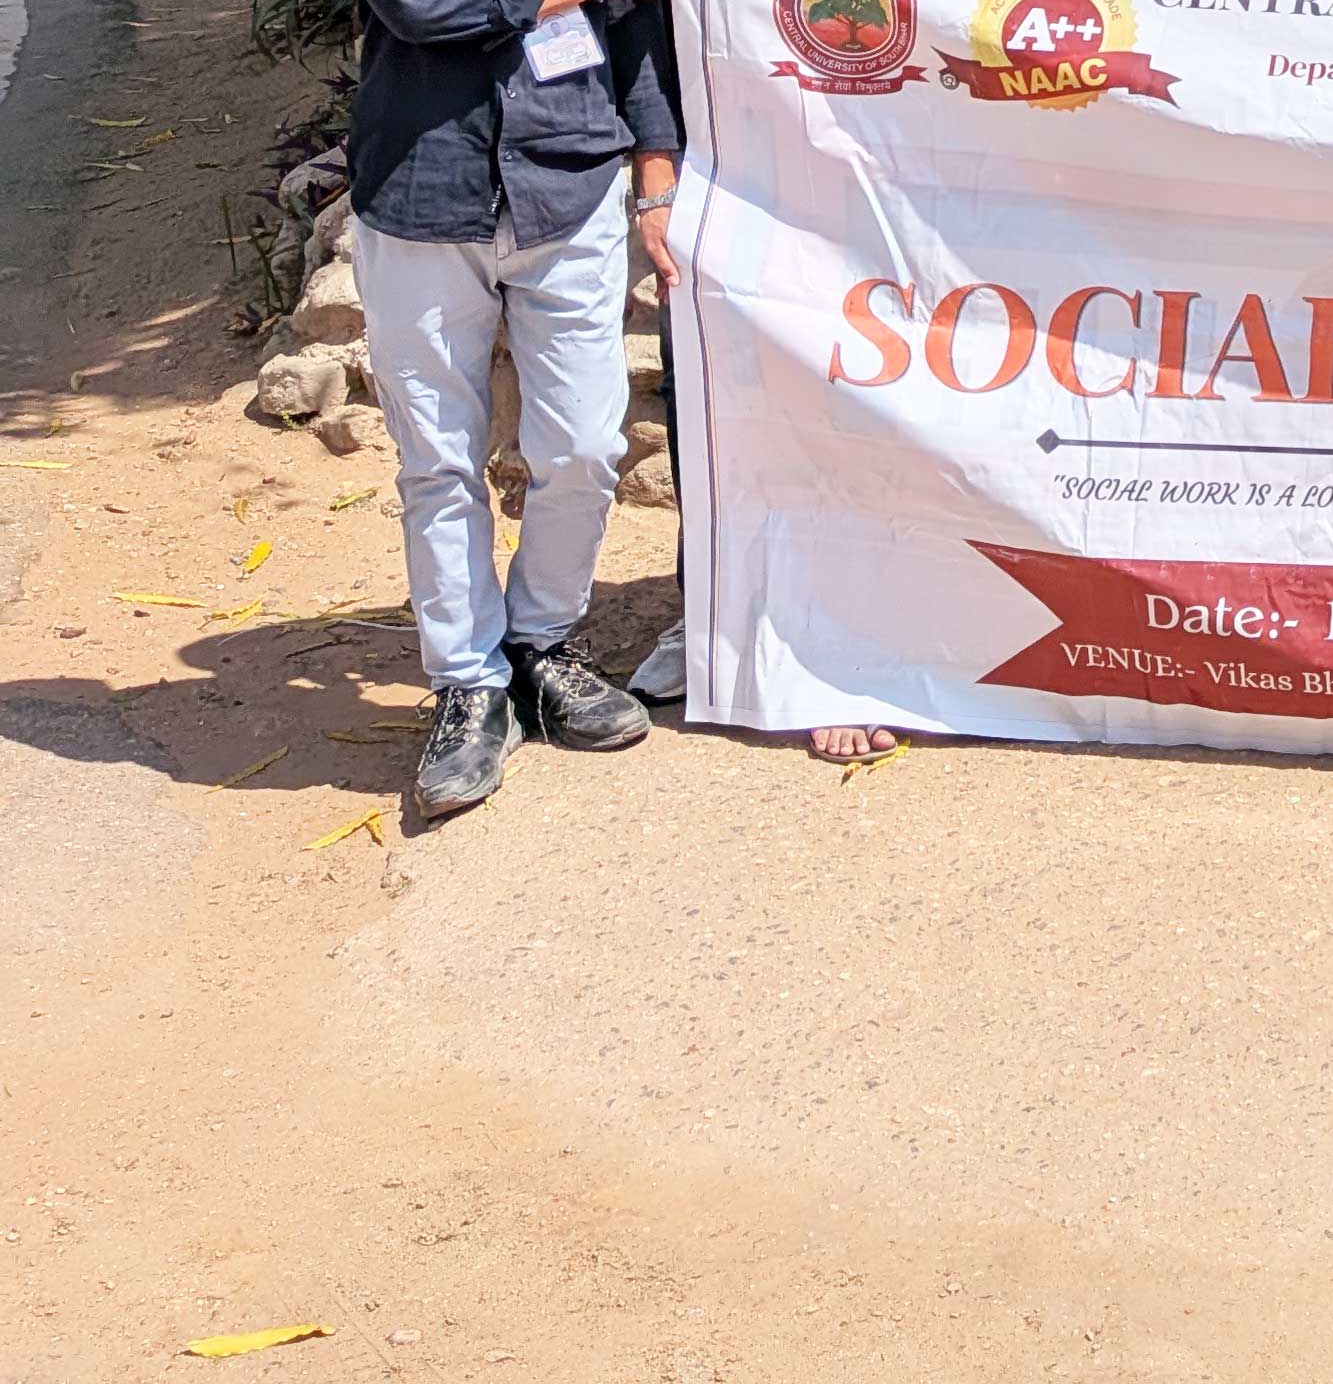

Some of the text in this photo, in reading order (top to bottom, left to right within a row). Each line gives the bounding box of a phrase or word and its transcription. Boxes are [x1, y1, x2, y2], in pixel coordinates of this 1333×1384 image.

[783, 11, 807, 51] CENTRAL
[808, 48, 863, 72] UNIVERSITY
[865, 59, 878, 71] OF
[879, 44, 902, 66] SOUTH
[1006, 7, 1102, 52] A++
[999, 58, 1108, 97] NAAC
[1159, 479, 1241, 506] WORK
[1244, 483, 1274, 506] IS
[1275, 484, 1297, 507] A
[1145, 593, 1299, 641] Date:-
[1058, 642, 1197, 680] VENUE:-
[1202, 660, 1293, 693] Vikas
